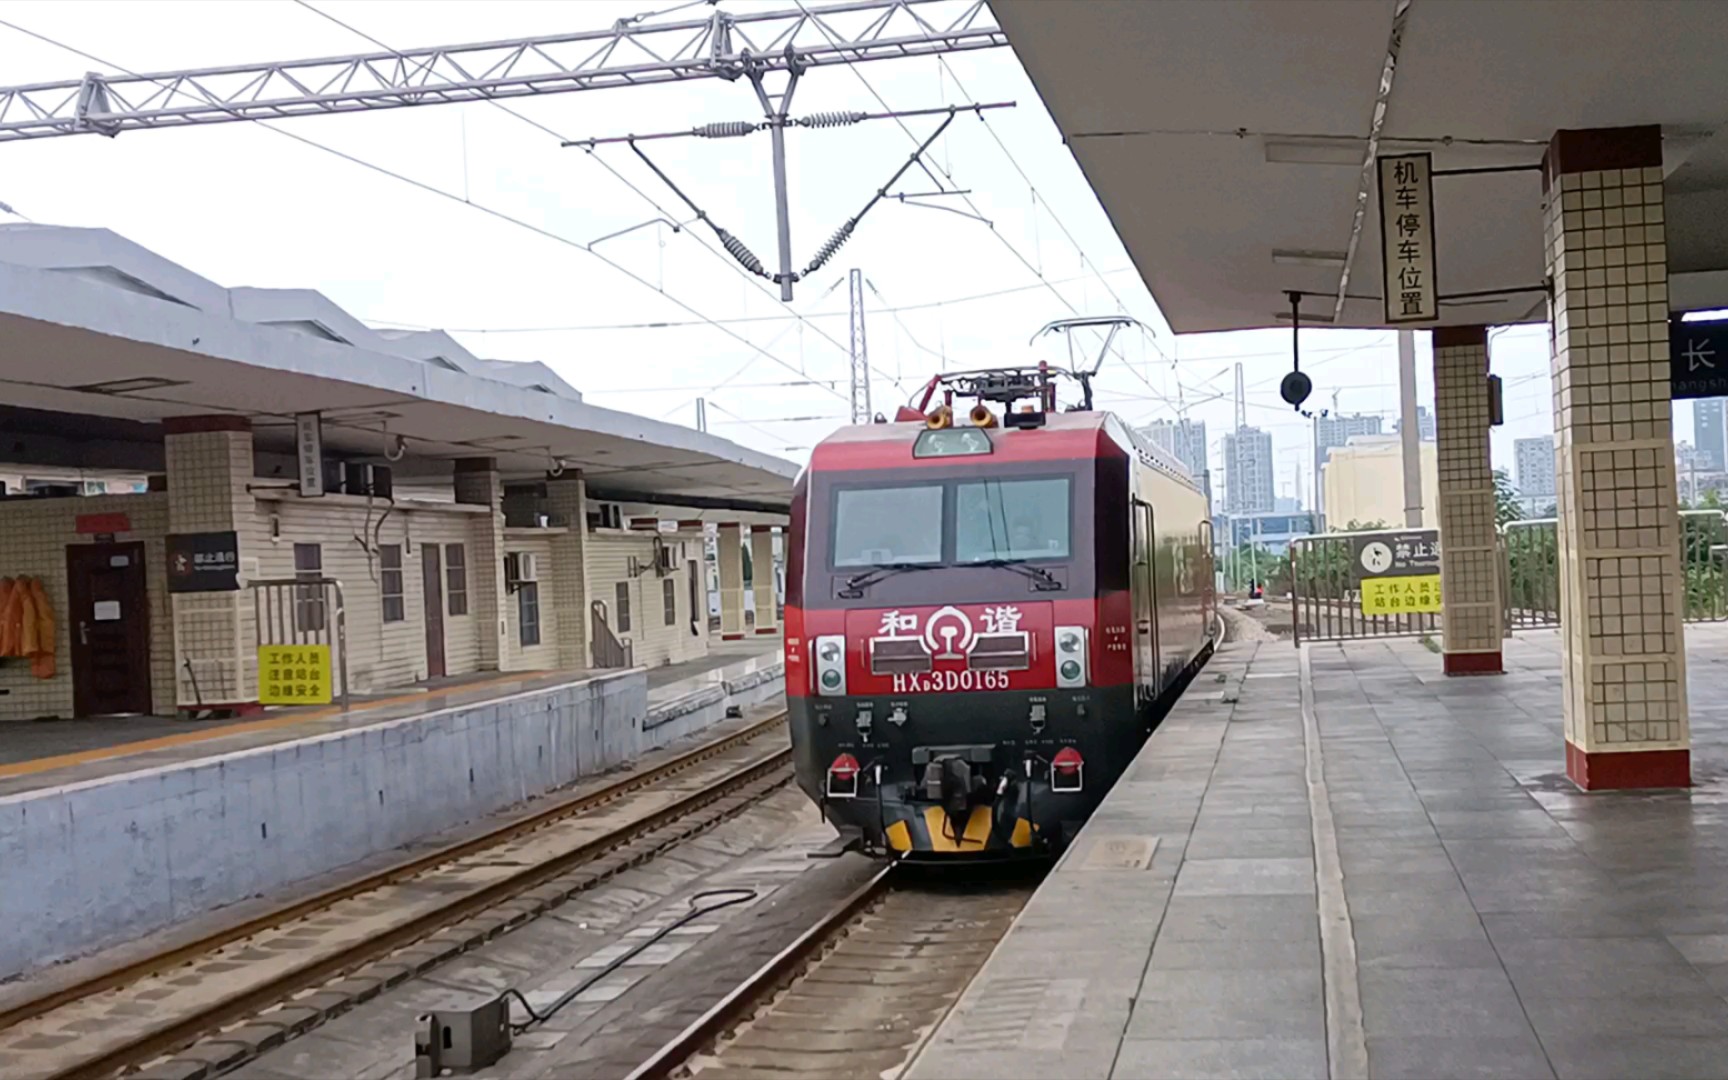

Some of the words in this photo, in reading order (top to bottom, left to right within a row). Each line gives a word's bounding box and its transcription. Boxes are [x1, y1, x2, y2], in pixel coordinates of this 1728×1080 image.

[1394, 161, 1423, 315] 机车停车位置
[1681, 338, 1716, 372] 长
[878, 609, 918, 637] 和
[980, 606, 1022, 633] 谐
